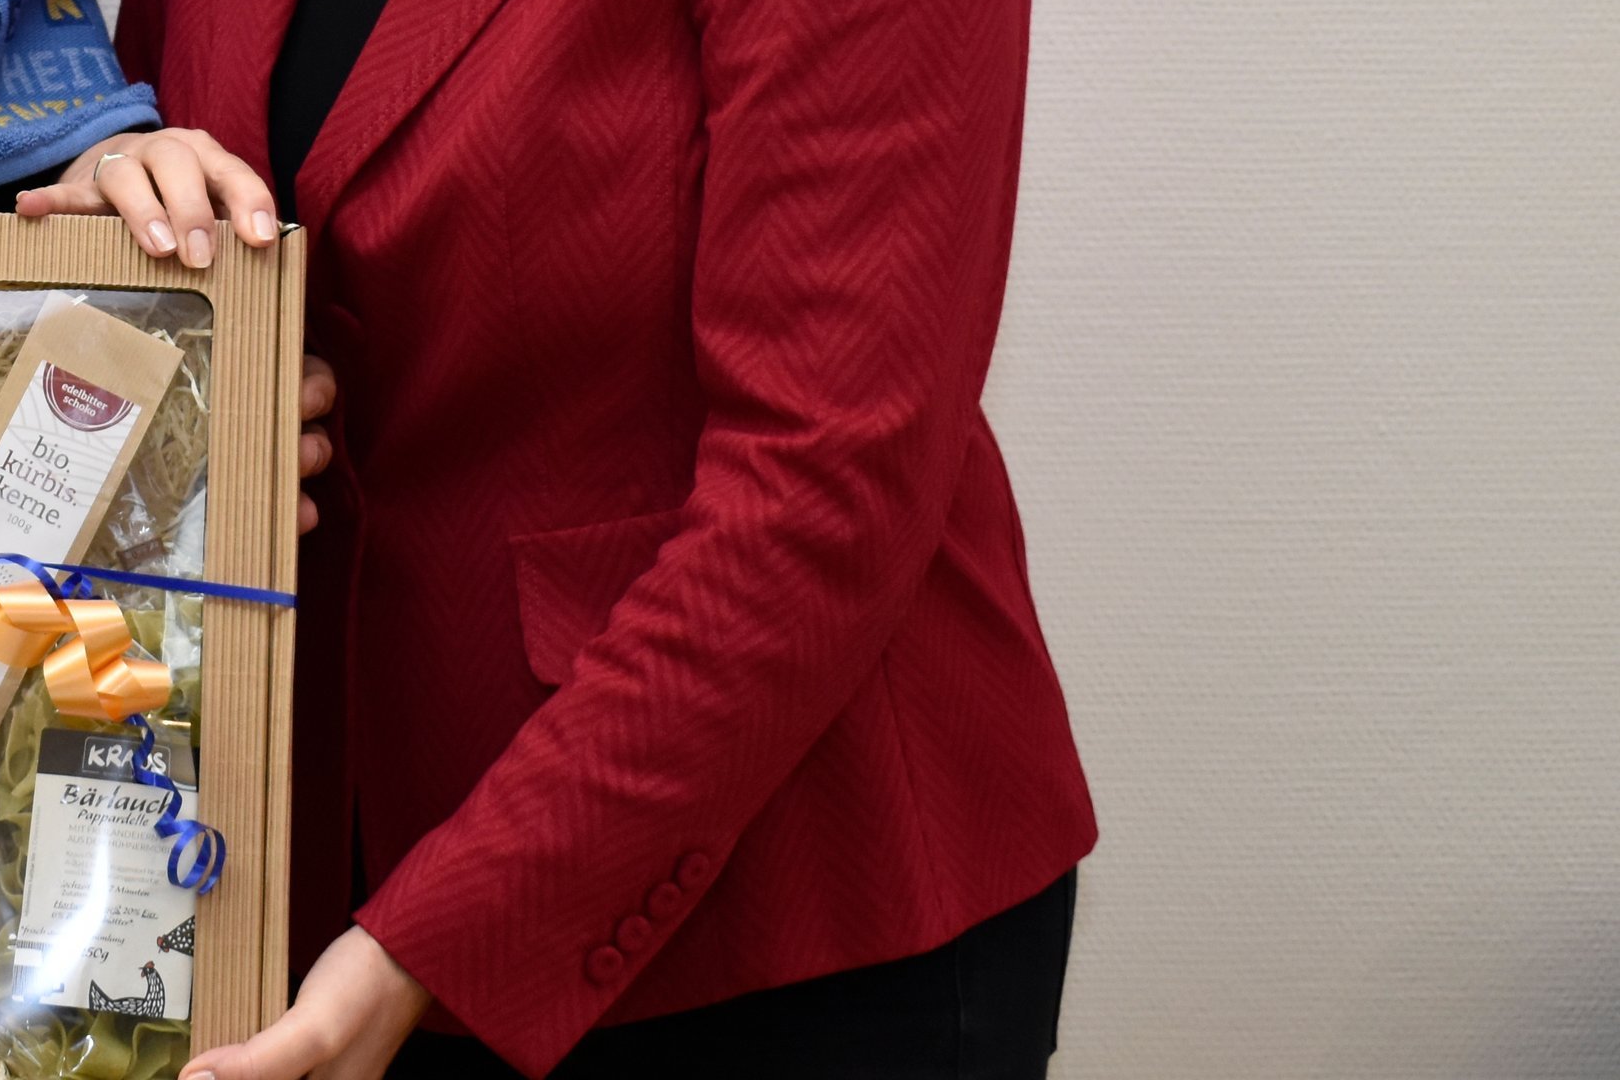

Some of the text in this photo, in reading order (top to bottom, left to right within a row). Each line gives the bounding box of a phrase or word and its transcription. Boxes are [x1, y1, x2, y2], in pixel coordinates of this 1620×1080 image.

[61, 383, 108, 411] edelbitter
[62, 395, 97, 418] schoko
[31, 435, 71, 474] bio.
[0, 450, 78, 507] kürbis.
[7, 513, 33, 535] 100g
[77, 808, 150, 827] Pappardelle
[82, 947, 110, 964] 50g
